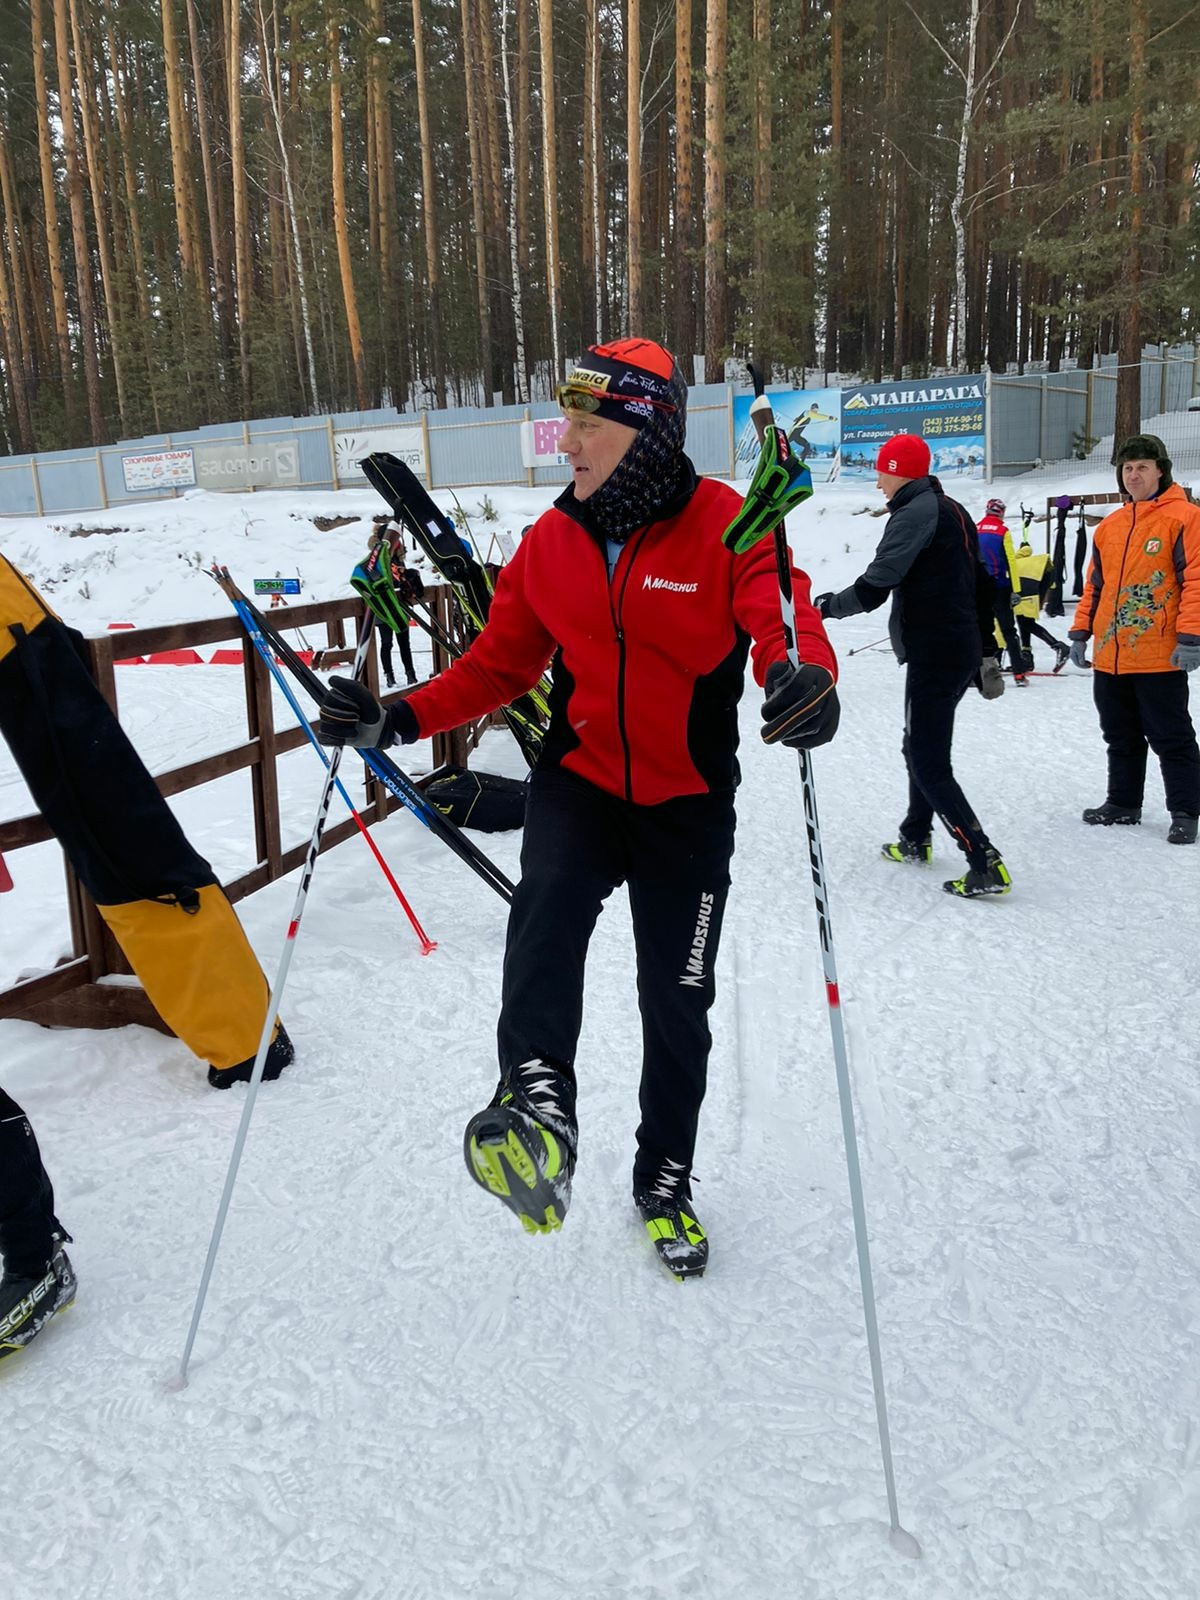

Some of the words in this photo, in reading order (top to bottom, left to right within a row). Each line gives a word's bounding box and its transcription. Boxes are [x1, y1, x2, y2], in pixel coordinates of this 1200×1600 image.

[870, 384, 983, 407] МАНАРАГА
[922, 418, 942, 427] (343)
[922, 427, 942, 436] (343)
[199, 456, 273, 477] salomon
[651, 578, 698, 592] MADSHUS
[383, 775, 417, 811] salomon
[685, 891, 714, 975] MADSHUS
[0, 1272, 57, 1339] SCHER
